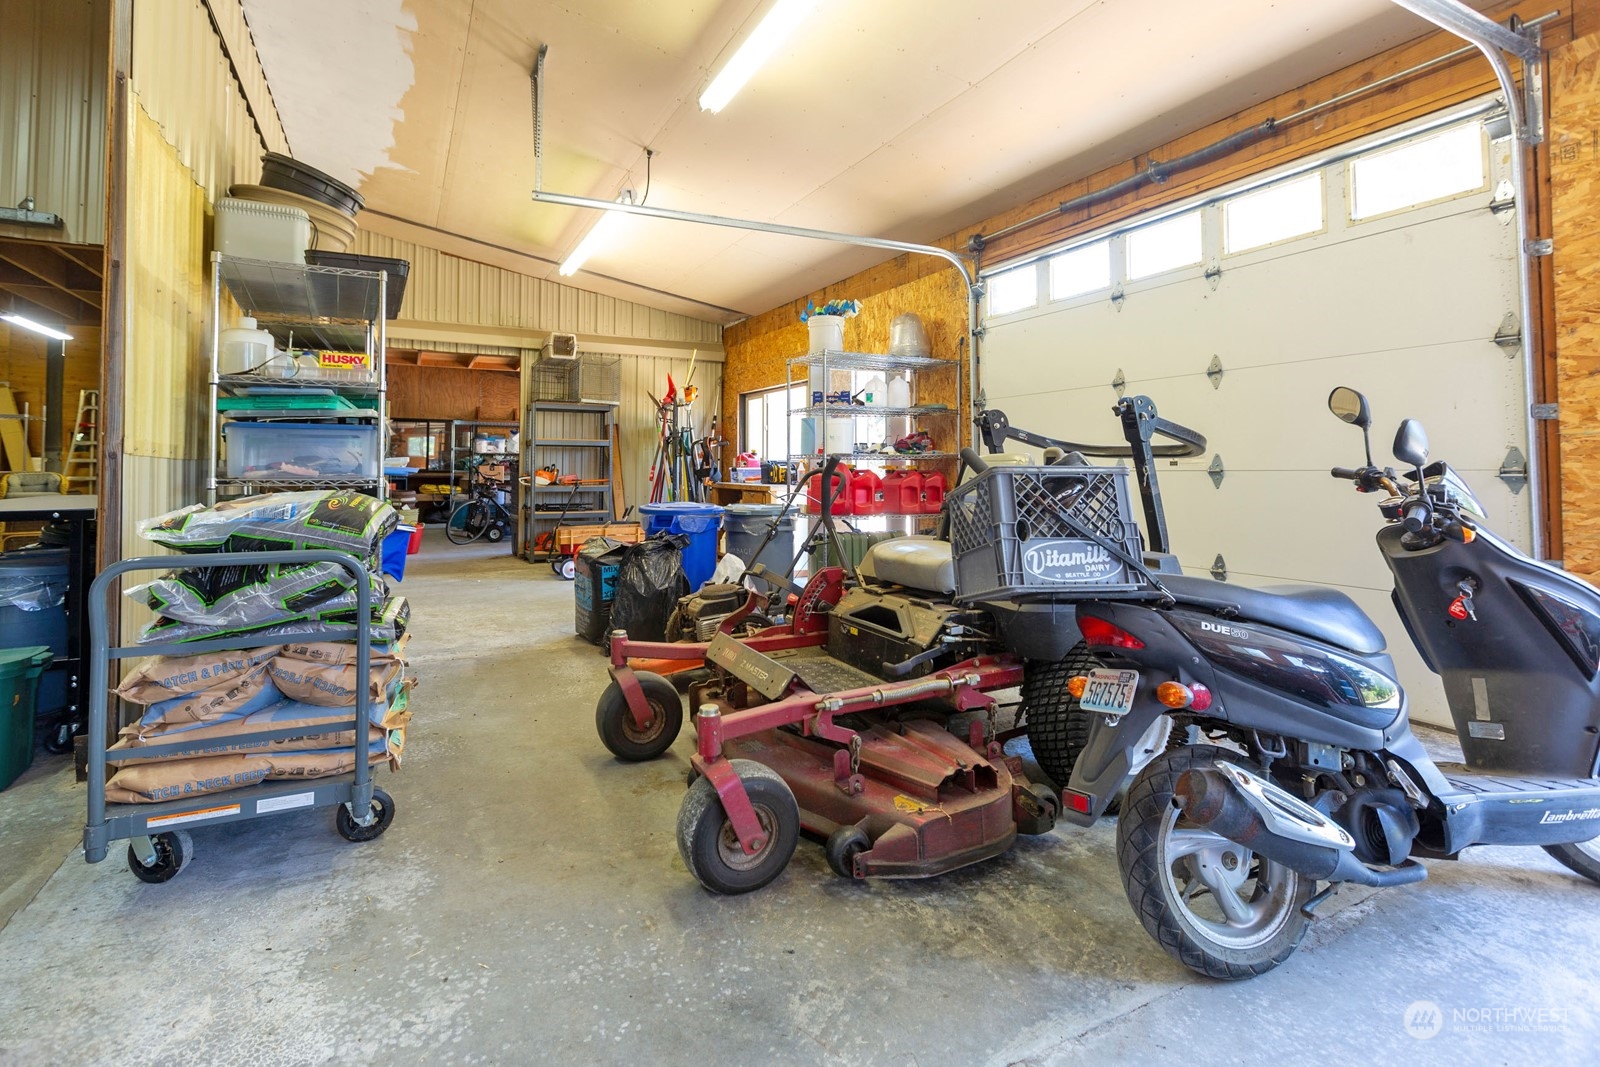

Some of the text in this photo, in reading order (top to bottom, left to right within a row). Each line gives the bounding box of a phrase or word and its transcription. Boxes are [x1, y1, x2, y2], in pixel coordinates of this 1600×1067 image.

[322, 354, 365, 365] HUSKY
[1027, 545, 1111, 574] Vitamilk
[1084, 563, 1111, 572] DAIRY
[201, 667, 211, 680] &
[1085, 681, 1128, 709] 5G7575
[184, 783, 192, 793] &
[196, 775, 231, 791] PECK
